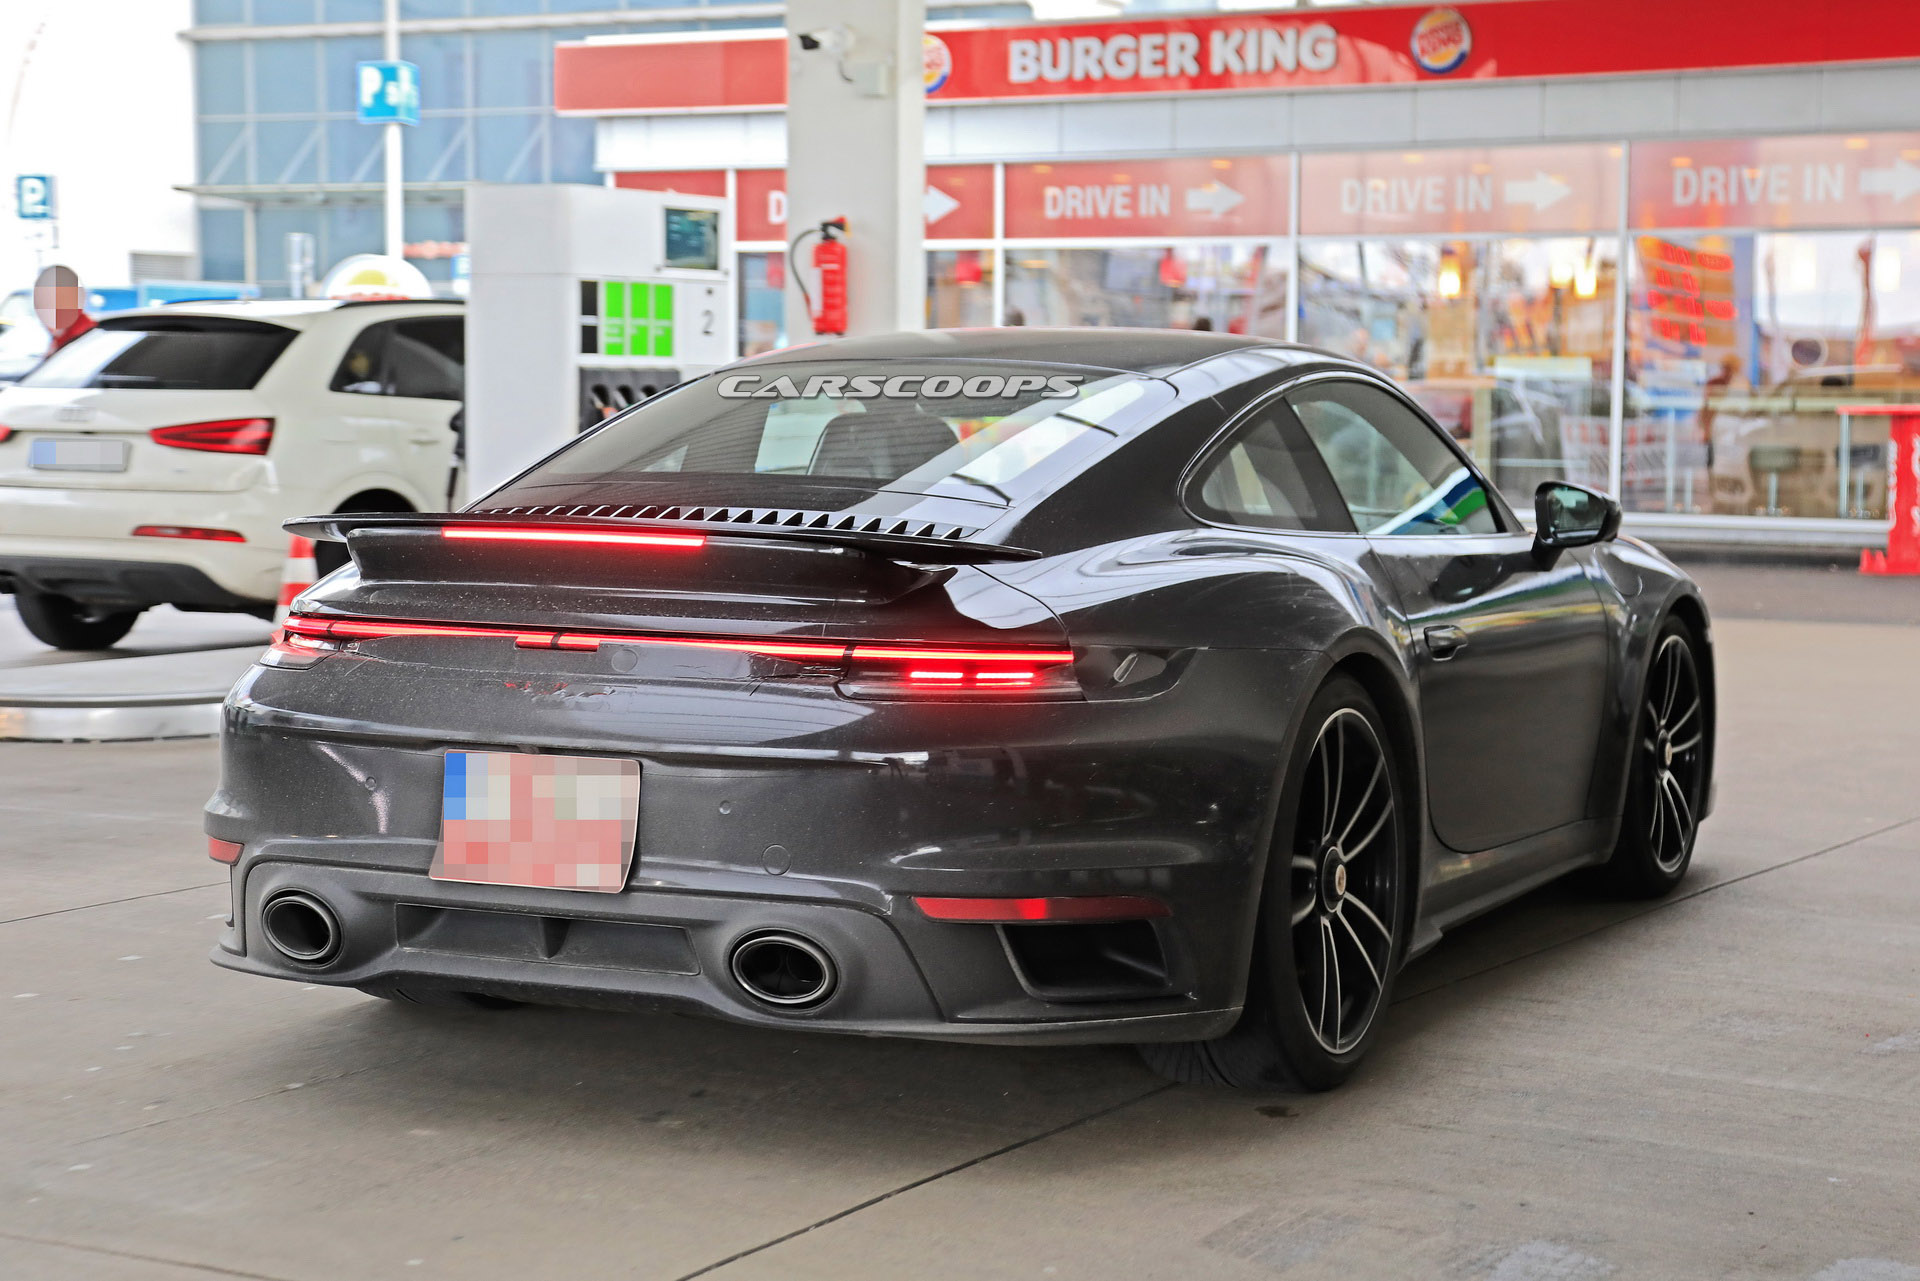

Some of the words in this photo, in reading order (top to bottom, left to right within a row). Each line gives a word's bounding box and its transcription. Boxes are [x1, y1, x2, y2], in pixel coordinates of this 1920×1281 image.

[1008, 33, 1200, 83] BURGER
[1209, 23, 1338, 76] KING
[359, 65, 384, 108] P
[20, 177, 46, 214] P
[1044, 184, 1133, 219] DRIVE
[1139, 184, 1171, 216] IN
[1340, 176, 1446, 214] DRIVE
[1455, 175, 1493, 212] IN
[1673, 164, 1792, 207] DRIVE
[1803, 163, 1845, 203] IN
[701, 310, 715, 336] 2
